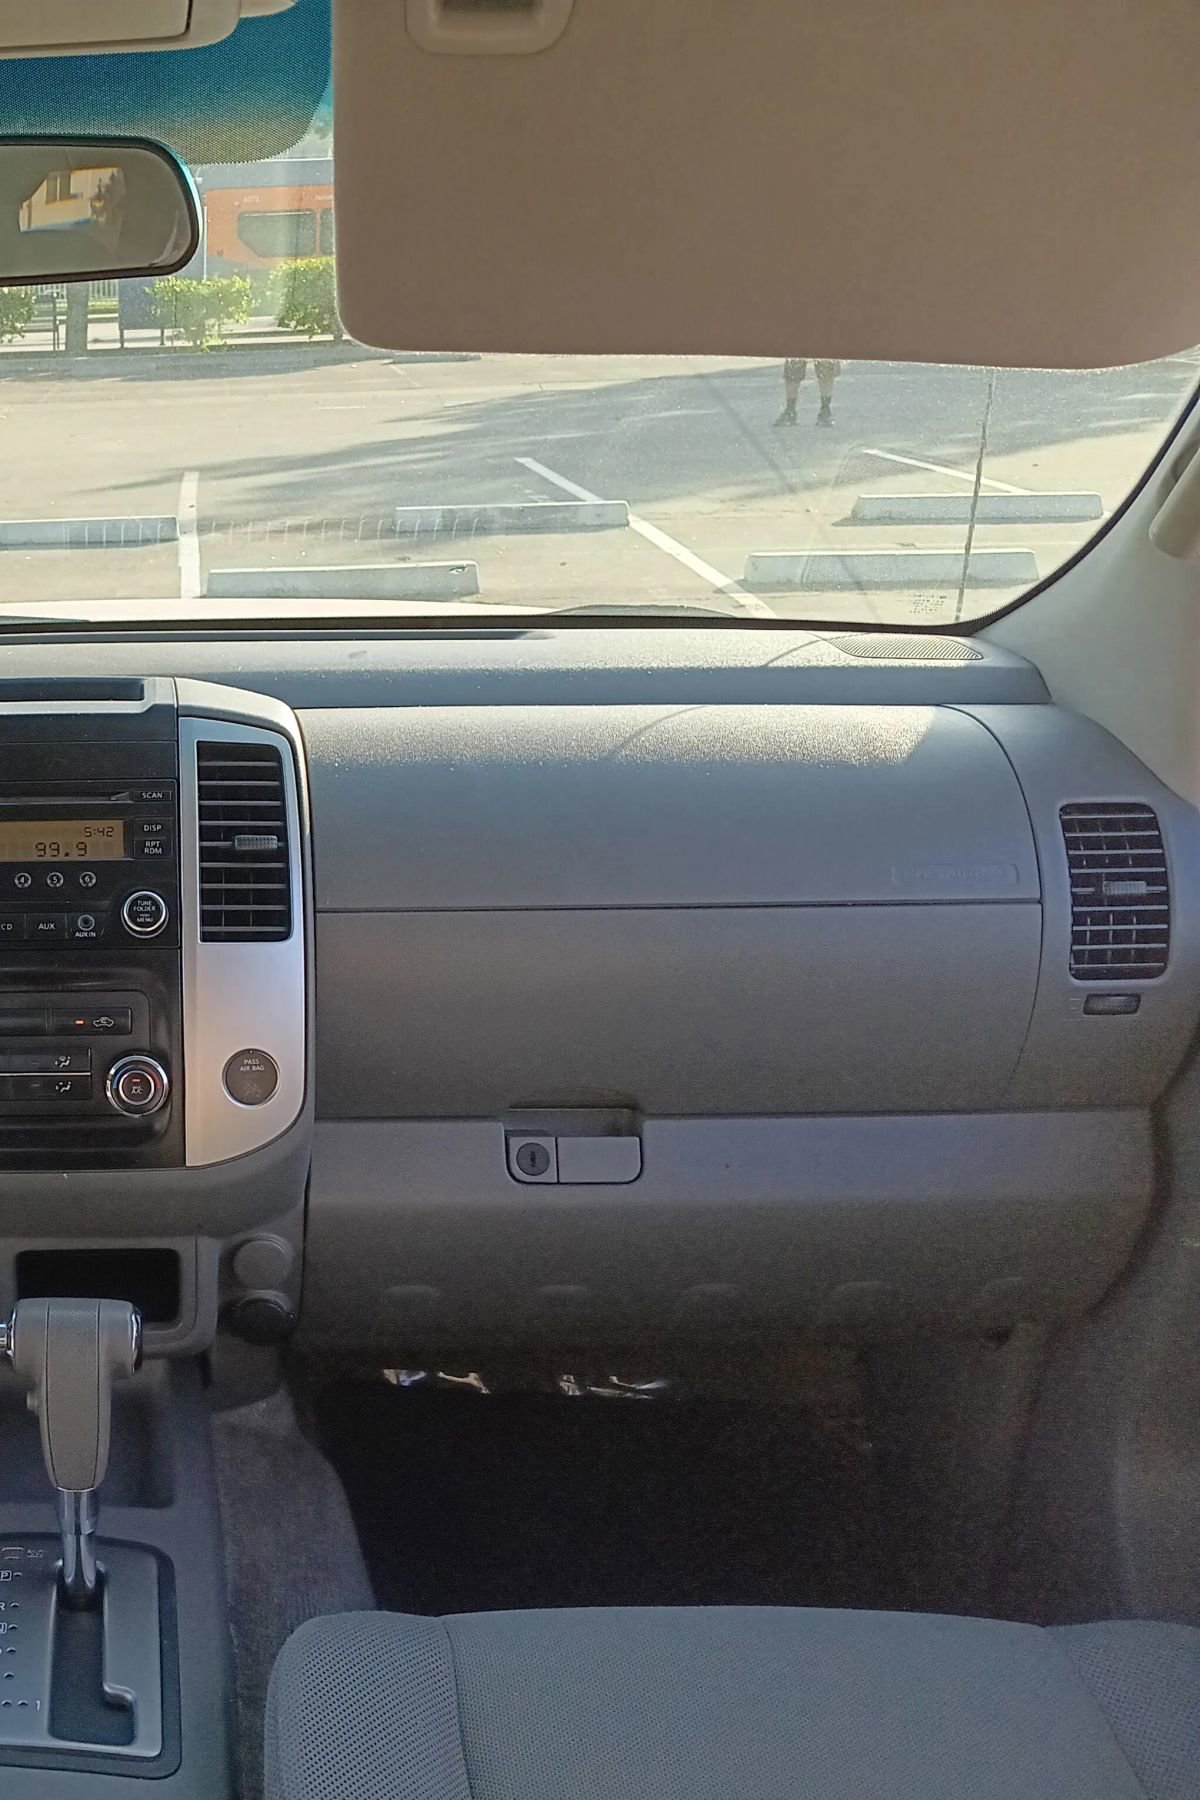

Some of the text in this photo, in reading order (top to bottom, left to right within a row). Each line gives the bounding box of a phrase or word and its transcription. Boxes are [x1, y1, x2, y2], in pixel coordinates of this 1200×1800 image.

[84, 826, 114, 838] 5:42
[143, 824, 162, 832] DISP
[145, 840, 161, 848] RPT
[35, 841, 88, 858] 99.9
[143, 847, 163, 855] RDM
[0, 923, 13, 931] CD
[38, 922, 56, 931] AUX
[35, 1700, 41, 1710] 1
